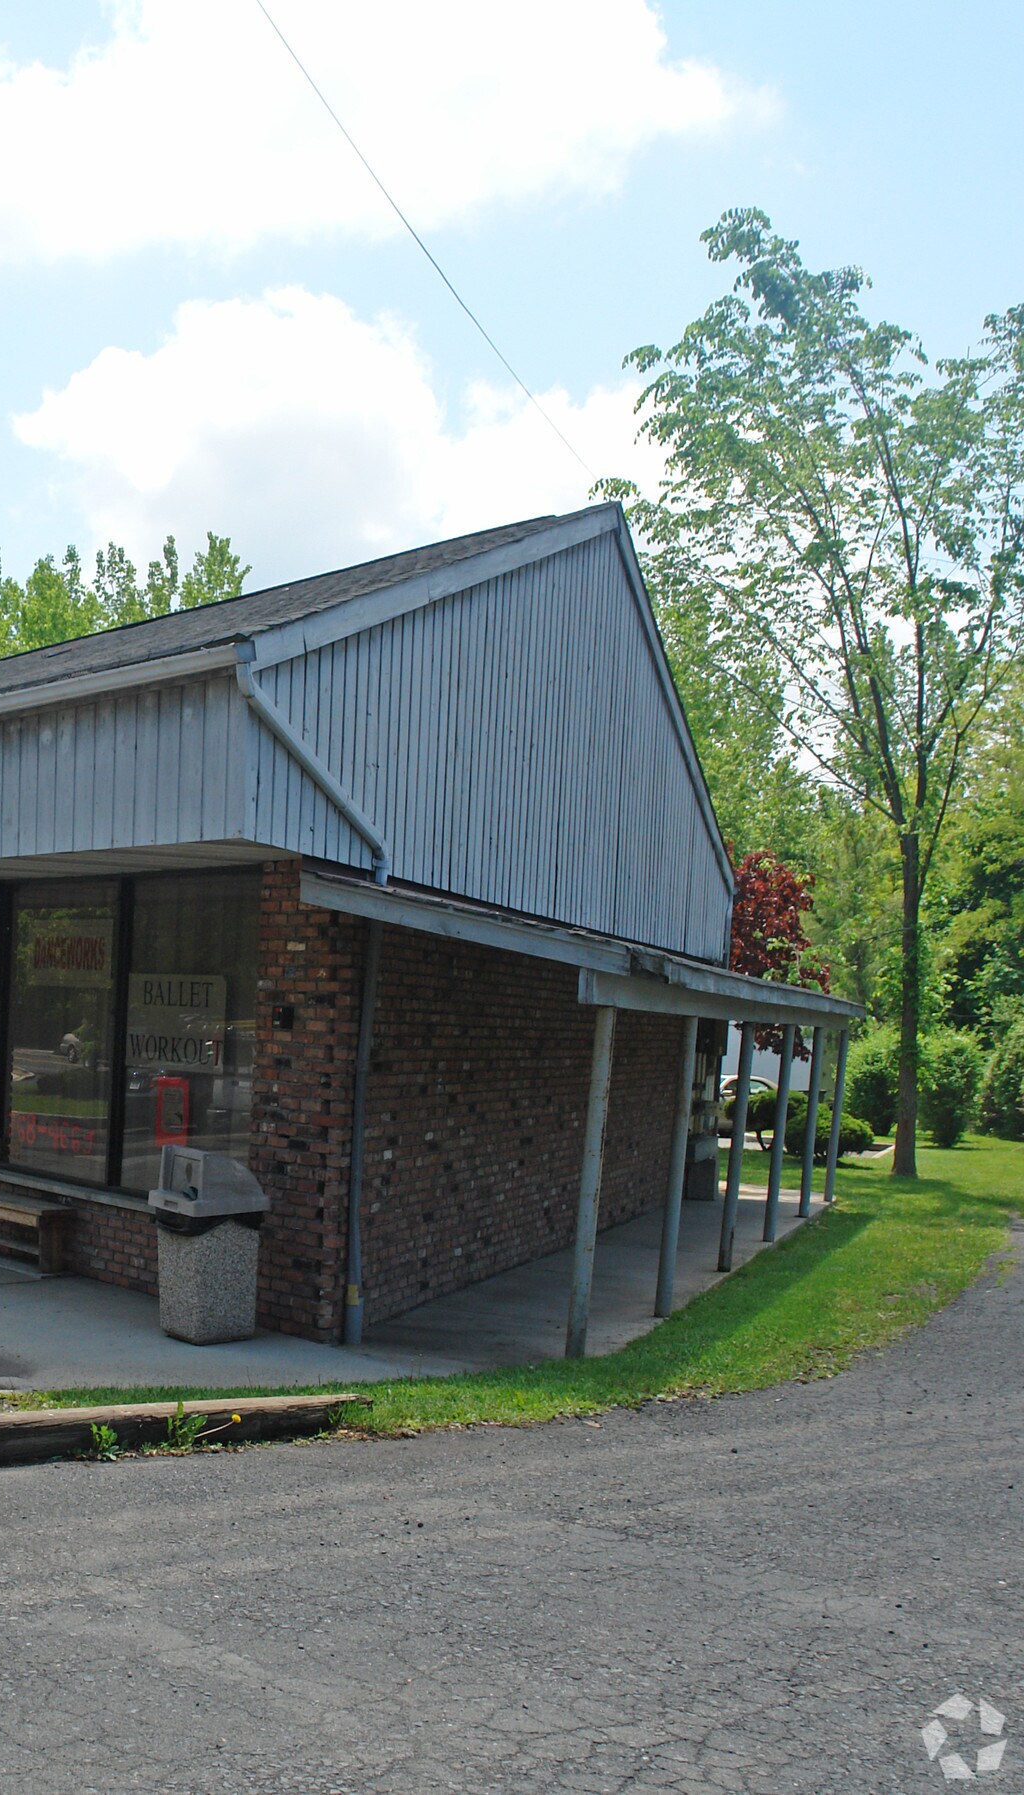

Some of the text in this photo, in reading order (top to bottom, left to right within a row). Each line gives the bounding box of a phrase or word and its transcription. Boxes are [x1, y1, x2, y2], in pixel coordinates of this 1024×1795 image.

[33, 935, 105, 970] DANCEWORKS
[143, 981, 213, 1008] BALLET
[129, 1034, 223, 1066] WORKOUT
